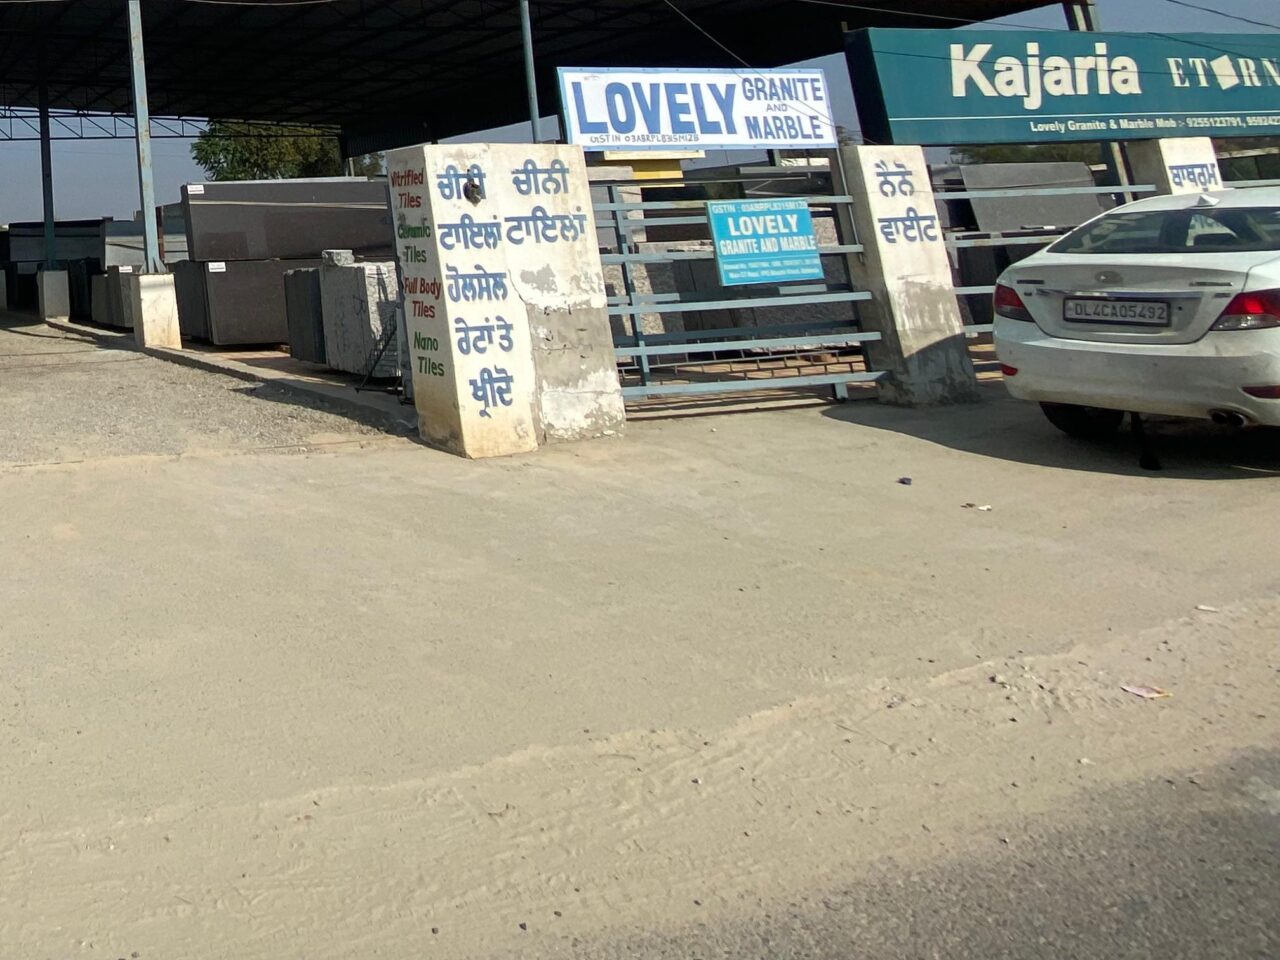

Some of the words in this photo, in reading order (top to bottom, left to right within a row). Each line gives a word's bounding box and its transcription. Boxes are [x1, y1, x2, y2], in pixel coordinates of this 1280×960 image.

[949, 42, 1142, 110] Kajaria
[741, 77, 823, 102] GRANITE
[571, 81, 737, 135] LOVELY
[766, 103, 788, 113] AND
[745, 115, 824, 140] MARBLE
[1030, 121, 1065, 133] Lovely
[1067, 120, 1107, 131] Granite
[1109, 119, 1117, 130] &
[1119, 119, 1154, 130] Marble
[391, 169, 424, 187] Vitrified
[511, 158, 570, 195] ਚੀਨੀ
[874, 159, 914, 197] ਨੈਨੋ
[399, 193, 422, 209] Tiles
[437, 213, 502, 250] ਟਾਇਲਾਂ
[504, 205, 587, 245] ਟਾਇਲਾਂ
[728, 214, 798, 236] LOVELY
[877, 206, 938, 244] ਵਾਈਟ
[404, 246, 427, 264] Tiles
[719, 238, 760, 256] GRANITE
[761, 237, 779, 252] AND
[780, 235, 817, 251] MARBLE
[404, 277, 419, 295] Full
[420, 278, 442, 300] Body
[445, 263, 508, 303] ਹੋਲਸੇਲ
[412, 301, 436, 319] Tiles
[414, 331, 439, 352] Nano
[454, 316, 495, 356] ਰੇਟਾਂ
[495, 315, 514, 353] ਤੇ
[418, 356, 445, 377] Tiles
